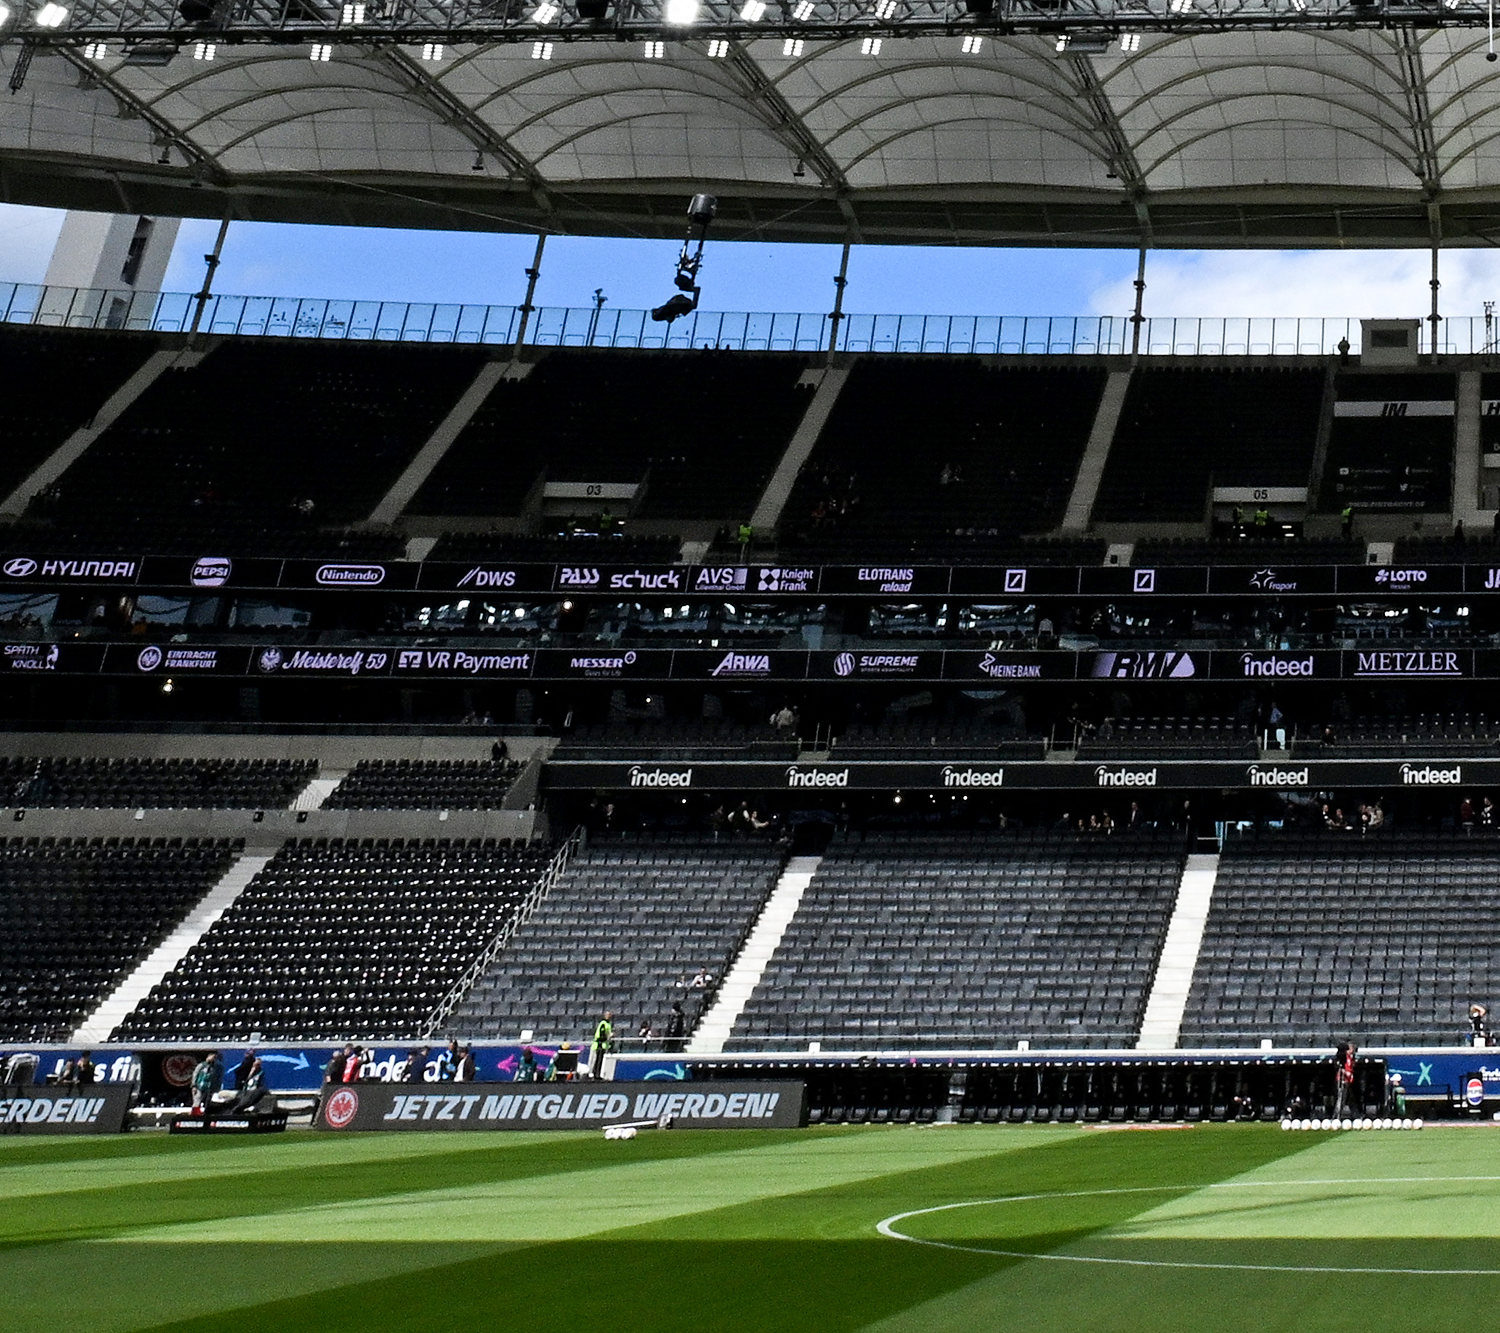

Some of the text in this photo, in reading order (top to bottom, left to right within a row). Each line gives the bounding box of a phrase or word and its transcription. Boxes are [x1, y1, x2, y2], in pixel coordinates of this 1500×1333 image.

[1382, 403, 1408, 416] IM
[586, 484, 602, 496] 03
[1253, 489, 1269, 500] 05
[41, 560, 136, 577] HYUNDAI
[194, 567, 228, 578] PEPSI
[322, 568, 380, 581] Nintendo
[696, 567, 734, 584] AVS
[781, 568, 814, 581] Knight
[857, 568, 914, 581] ELOTRANS
[1390, 569, 1428, 582] LOTTO
[477, 571, 516, 587] DWS
[780, 580, 808, 592] Frank
[879, 581, 912, 593] reload
[167, 650, 217, 660] EINTRACHT
[426, 651, 530, 674] VR Payment
[570, 656, 624, 669] MESSER
[859, 656, 919, 666] SUPREME
[1357, 651, 1459, 670] METZLER
[164, 659, 217, 669] FRANKFURT
[282, 652, 388, 675] Meisterelf 59
[712, 651, 771, 676] ARWA
[1240, 652, 1314, 676] indeed
[628, 765, 692, 787] indeed
[786, 765, 848, 787] indeed
[941, 765, 1003, 787] indeed
[1096, 765, 1157, 787] indeed
[1247, 764, 1309, 786] indeed
[1399, 763, 1461, 785] indeed
[383, 1092, 780, 1121] JETZT MITGLIED WERDEN!
